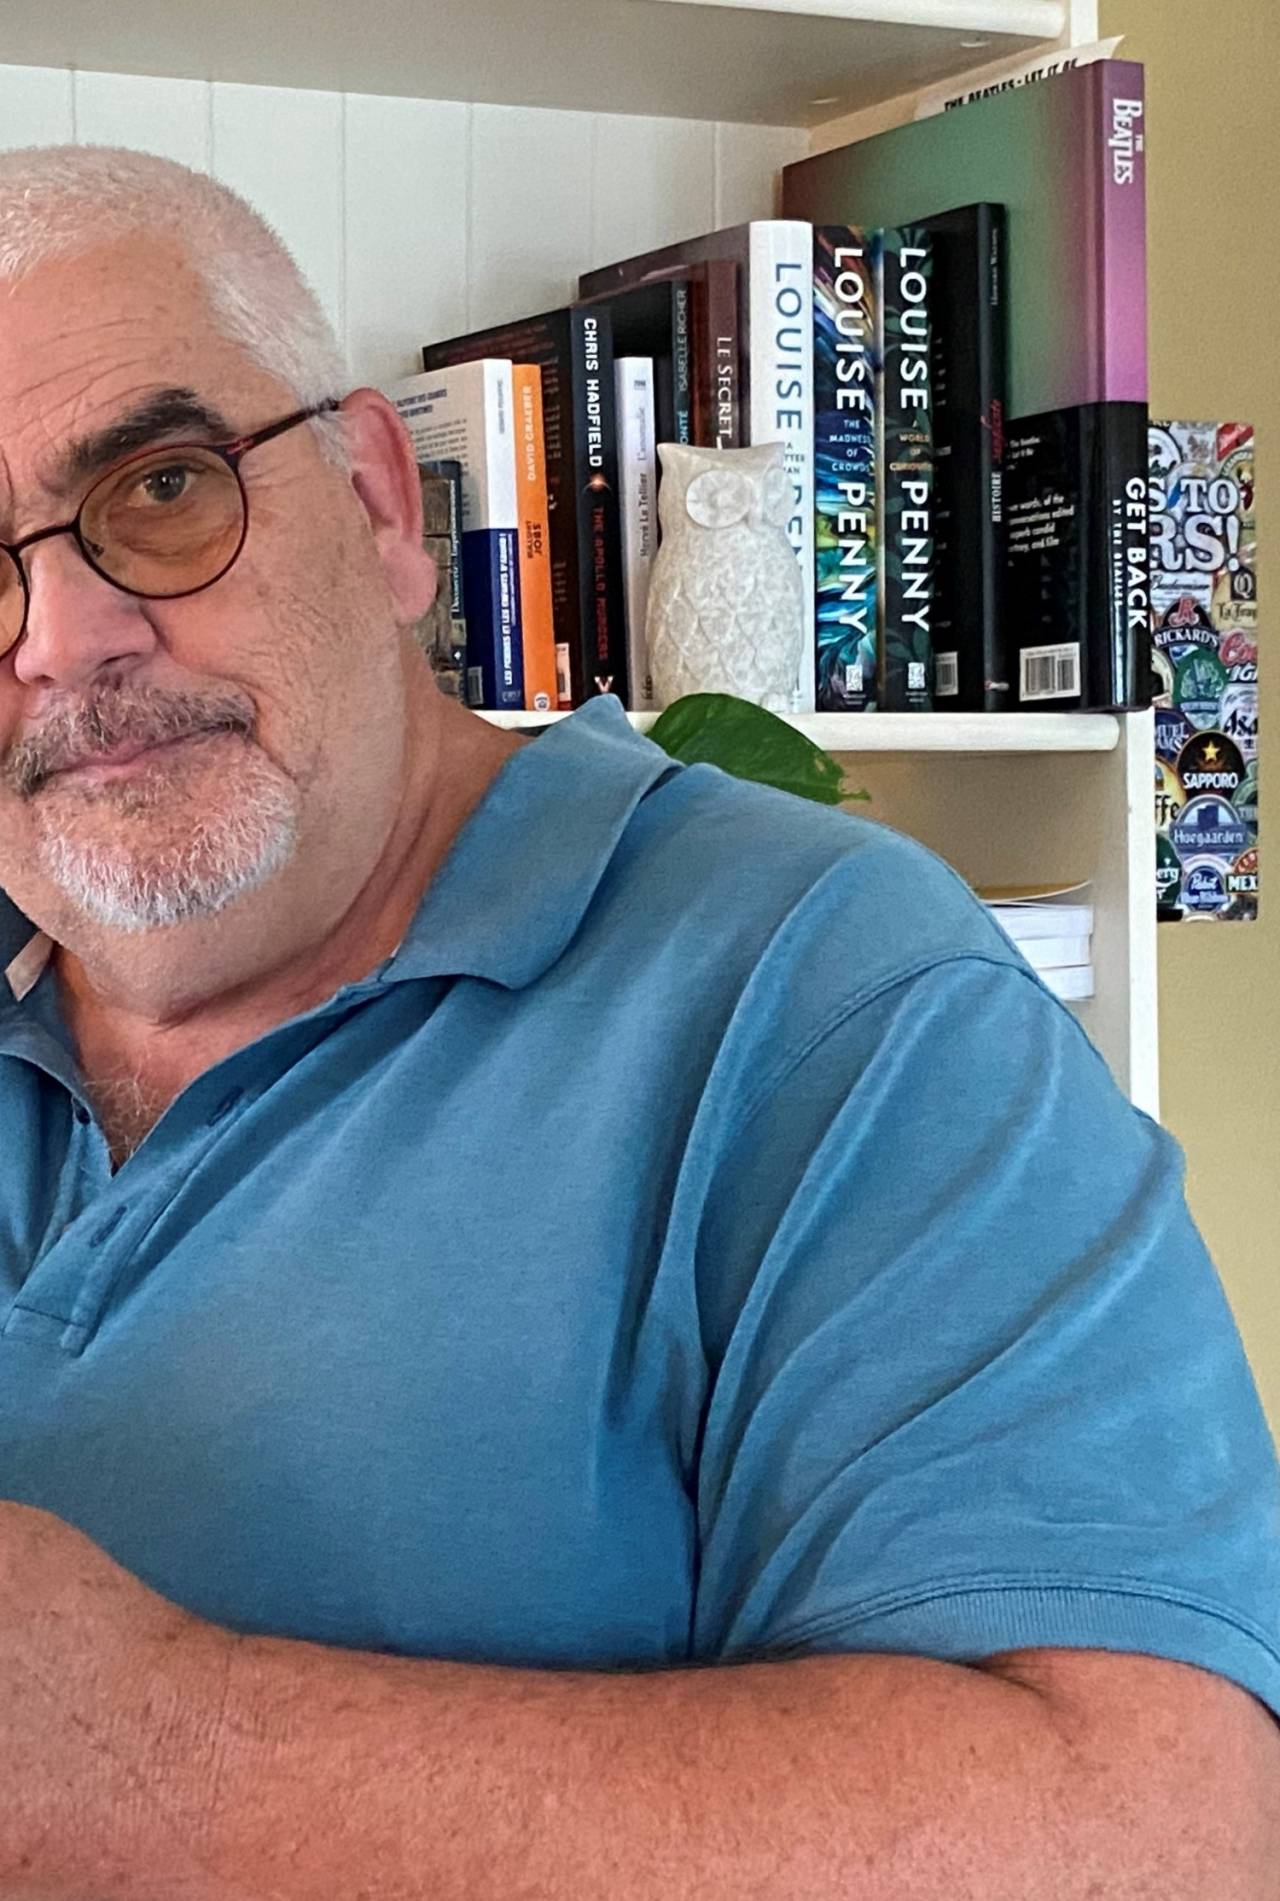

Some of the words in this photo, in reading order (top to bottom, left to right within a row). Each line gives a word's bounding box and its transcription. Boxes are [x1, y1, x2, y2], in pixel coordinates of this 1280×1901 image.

[1107, 98, 1143, 186] BEATLES
[675, 289, 688, 337] RICHER
[835, 247, 865, 410] LOUISE
[900, 247, 928, 410] LOUISE
[583, 318, 600, 370] CHRIS
[677, 337, 690, 391] ISABELLE
[716, 336, 733, 357] LE
[775, 263, 803, 430] LOUISE
[521, 386, 535, 441] GRAEBER
[587, 379, 603, 466] HADFIELD
[716, 365, 734, 439] SECRET
[829, 434, 871, 444] MADNESS
[843, 419, 861, 429] THE
[525, 444, 537, 481] DAVID
[784, 454, 805, 462] TTER
[846, 449, 858, 458] OF
[637, 472, 649, 506] Tellier
[991, 472, 1002, 522] HISTOIRE
[1112, 499, 1122, 515] BY
[1125, 477, 1147, 534] GET
[1179, 478, 1239, 514] TO
[533, 523, 543, 555] JOBS
[591, 506, 606, 532] THE
[1112, 523, 1123, 545] THE
[637, 525, 650, 556] Hervé
[837, 482, 867, 634] PENNY
[902, 481, 929, 632] PENNY
[593, 537, 607, 591] APOLLO
[1126, 547, 1148, 629] BACK
[1154, 627, 1218, 647] RICKARD'S
[1183, 771, 1239, 790] SAPPORO
[1173, 828, 1245, 848] Hoegaarden
